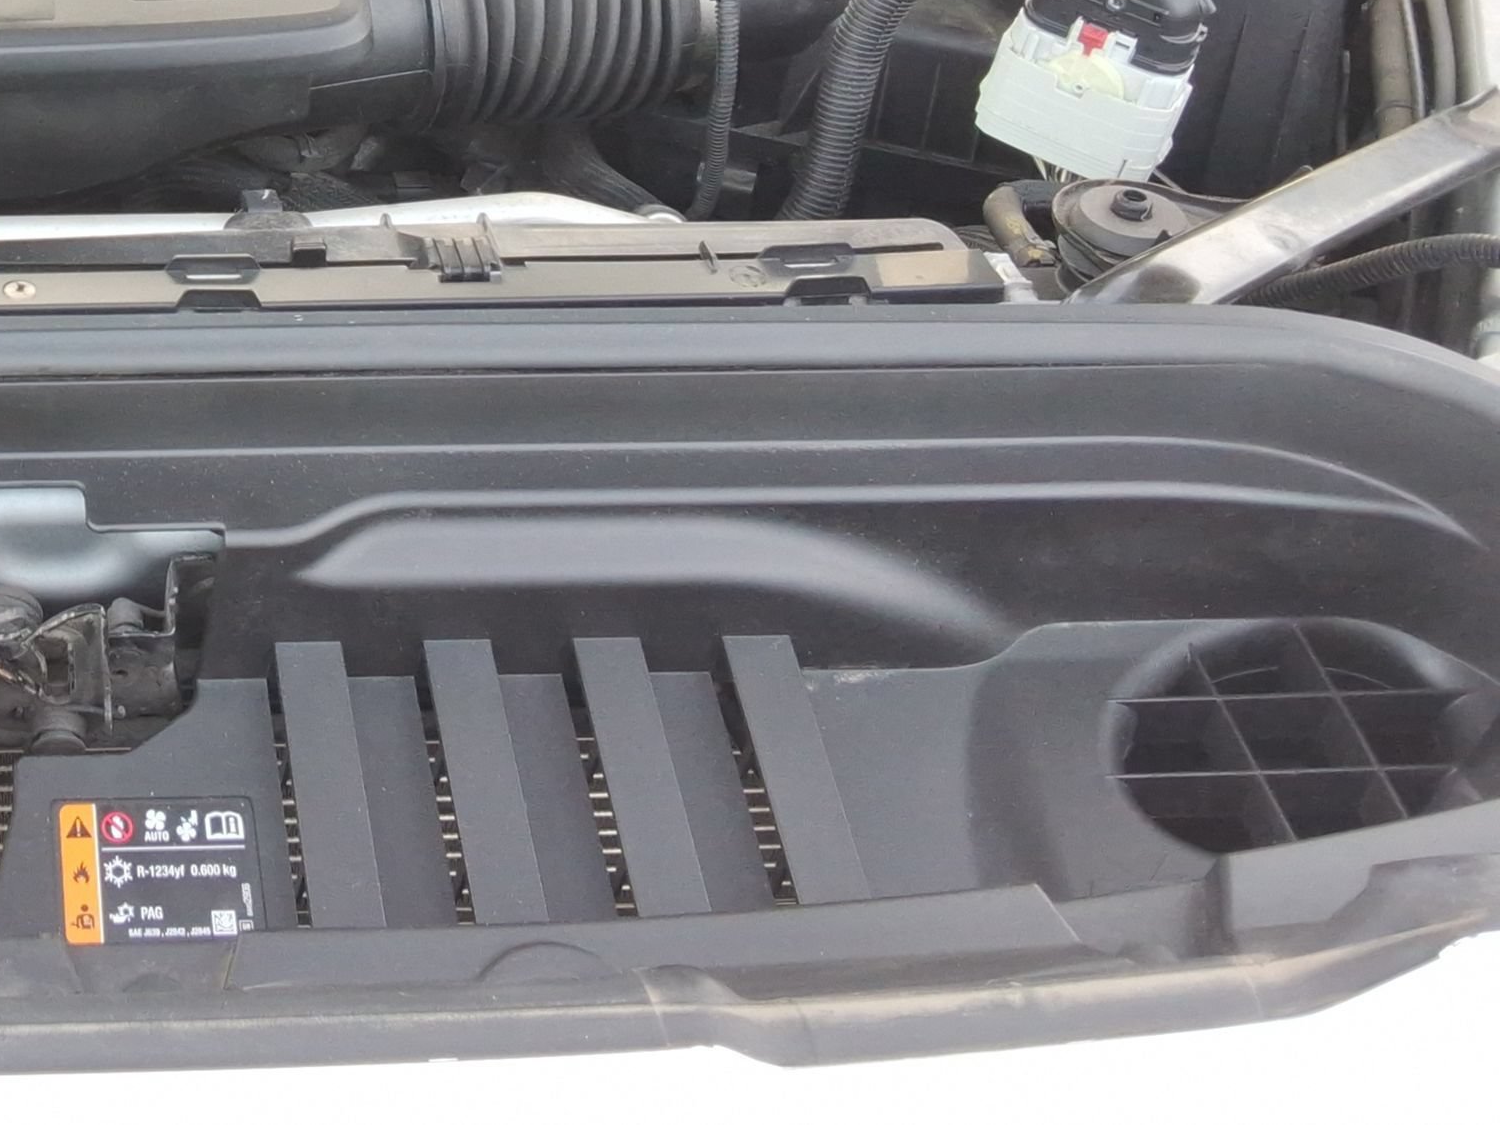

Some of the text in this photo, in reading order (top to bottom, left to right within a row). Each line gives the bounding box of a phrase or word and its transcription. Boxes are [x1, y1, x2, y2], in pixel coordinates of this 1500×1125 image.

[144, 830, 170, 843] AUTO
[137, 863, 237, 879] R-1234yf 0.600 kg
[140, 906, 164, 920] PAG
